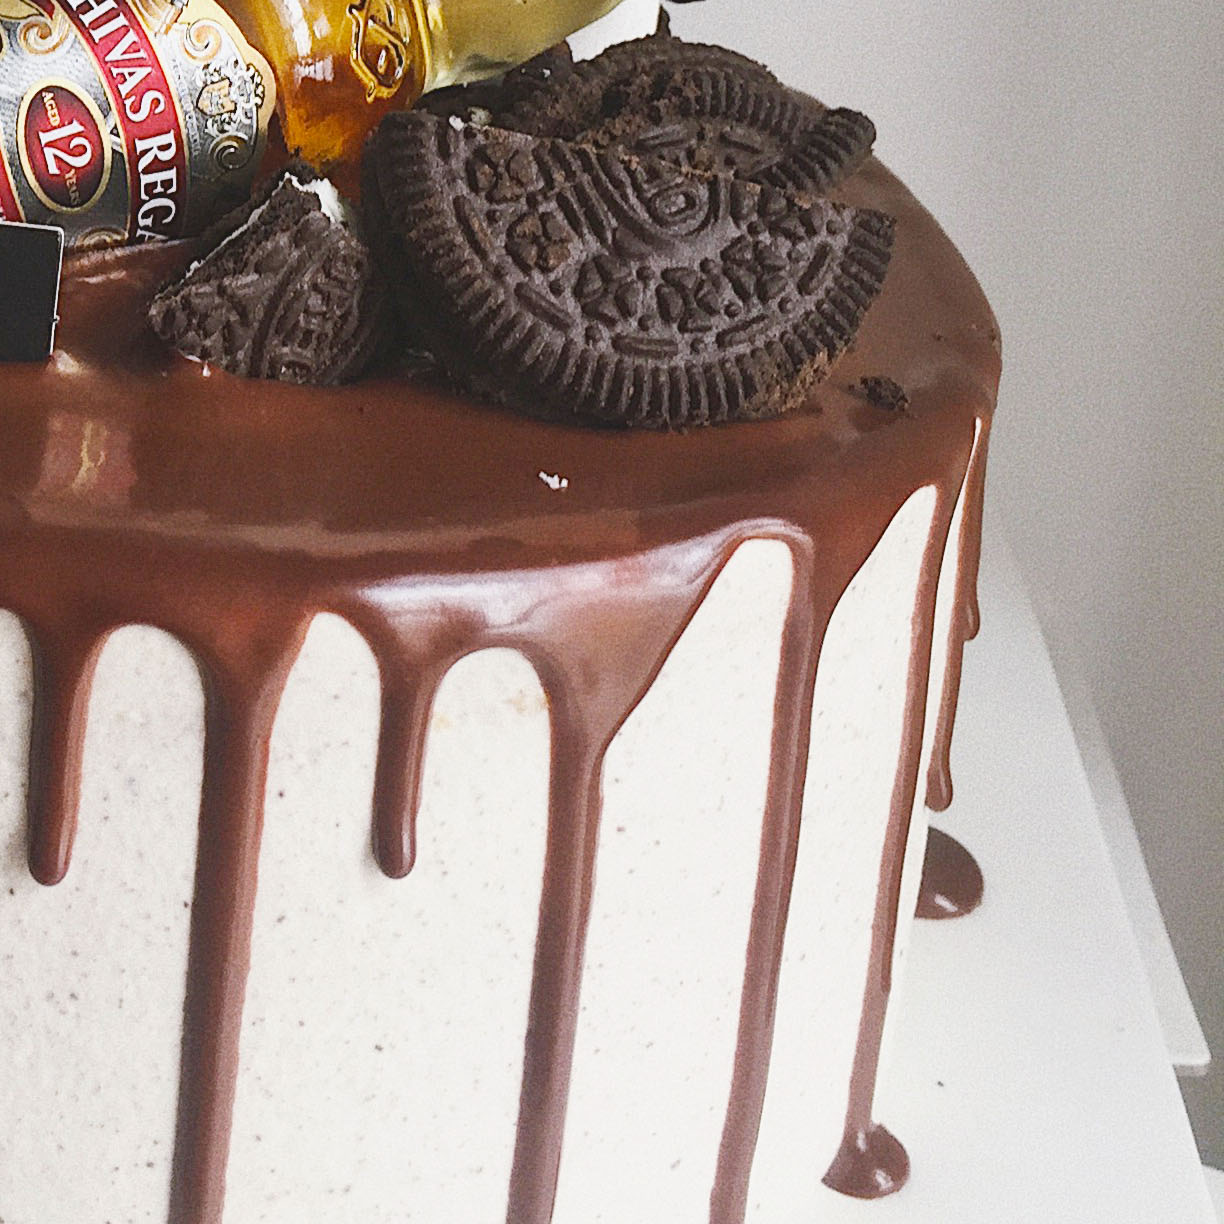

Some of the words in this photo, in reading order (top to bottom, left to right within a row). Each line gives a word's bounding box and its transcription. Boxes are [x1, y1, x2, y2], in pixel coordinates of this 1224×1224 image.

[41, 91, 61, 127] AGED
[38, 119, 92, 175] 12
[64, 168, 81, 206] YEARS
